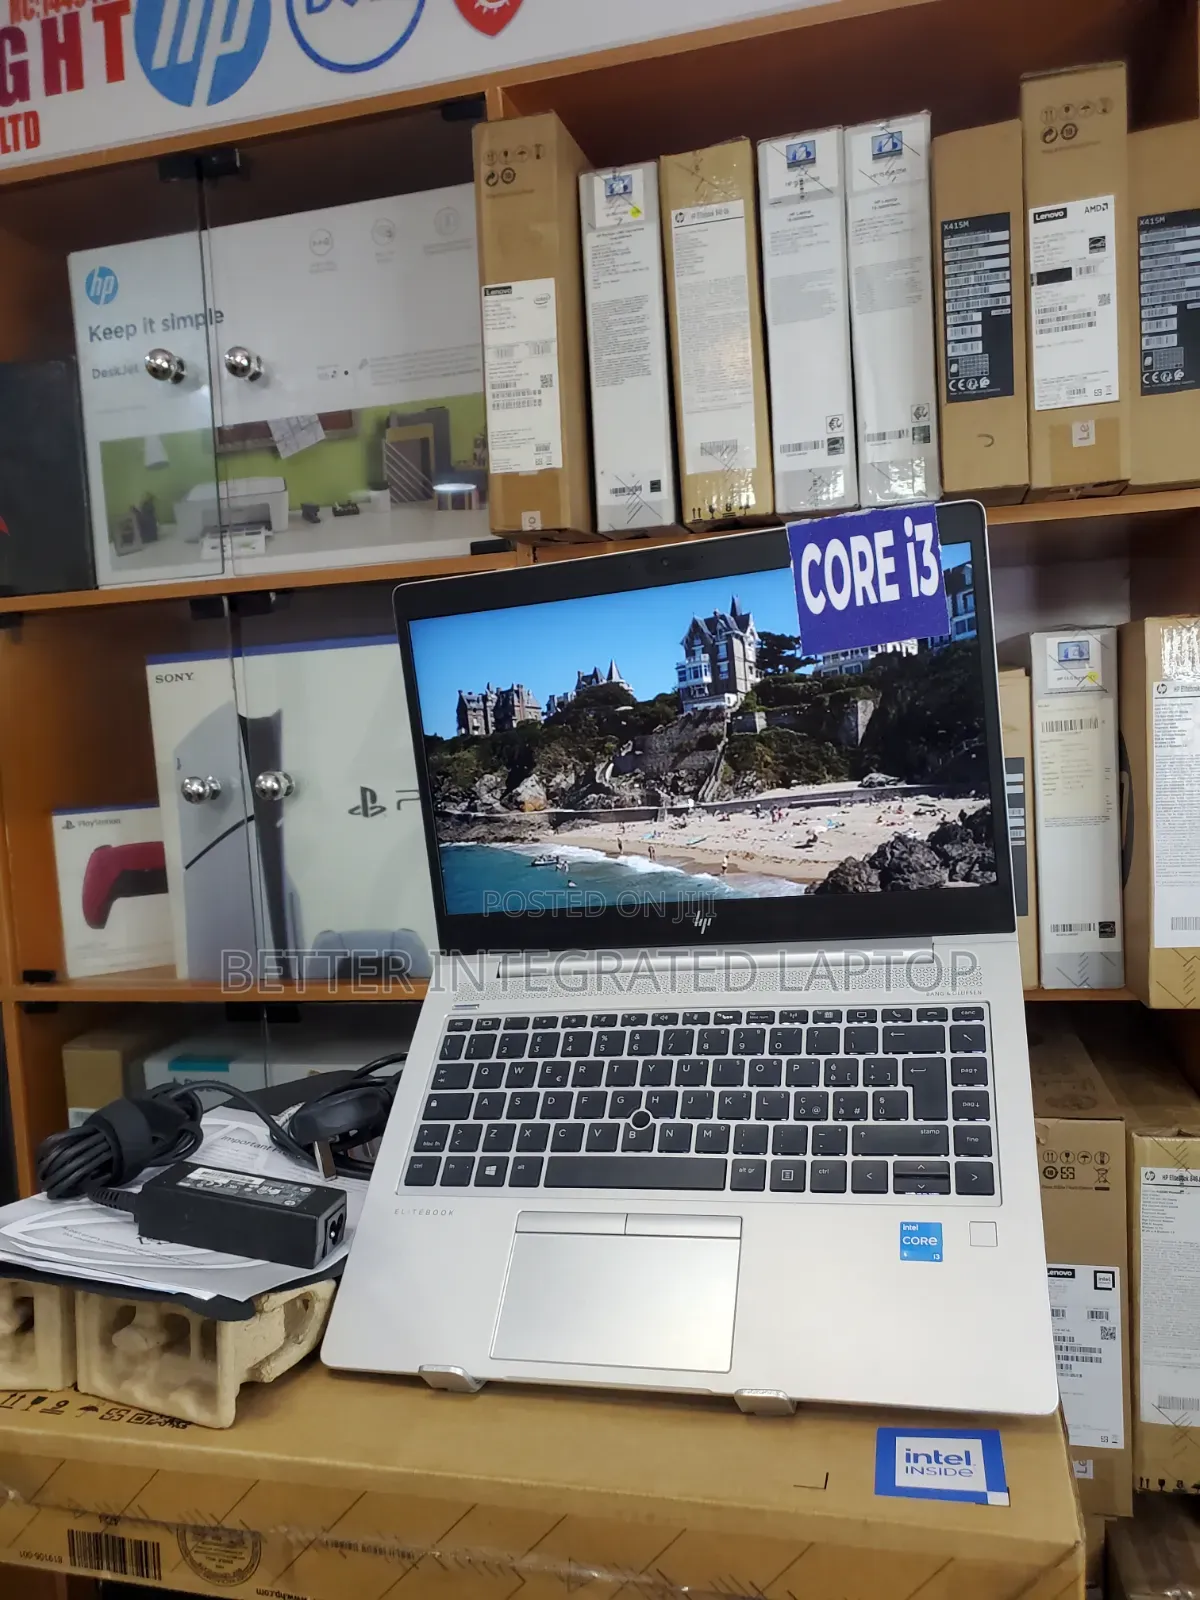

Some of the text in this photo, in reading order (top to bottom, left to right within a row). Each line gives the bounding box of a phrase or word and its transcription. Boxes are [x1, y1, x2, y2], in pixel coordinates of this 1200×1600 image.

[0, 0, 131, 107] GHT
[0, 111, 41, 154] LTD
[1085, 204, 1101, 214] AMD
[1035, 210, 1065, 221] Lenovo
[943, 220, 970, 231] X415M
[1140, 216, 1166, 226] X415M
[88, 267, 117, 305] hp
[88, 308, 224, 342] Keep it simple
[801, 516, 939, 614] CORE i3
[155, 672, 194, 684] SONY
[514, 1066, 525, 1075] W
[682, 1064, 691, 1073] U
[547, 1096, 556, 1105] D
[616, 1095, 625, 1104] G
[651, 1095, 660, 1104] H
[724, 1096, 733, 1105] K
[811, 1105, 821, 1115] @
[489, 1129, 498, 1138] Z
[558, 1128, 567, 1138] C
[628, 1130, 637, 1139] B
[665, 1129, 674, 1138] N
[703, 1129, 712, 1138] M
[220, 1135, 272, 1151] Important
[905, 1448, 972, 1466] intel
